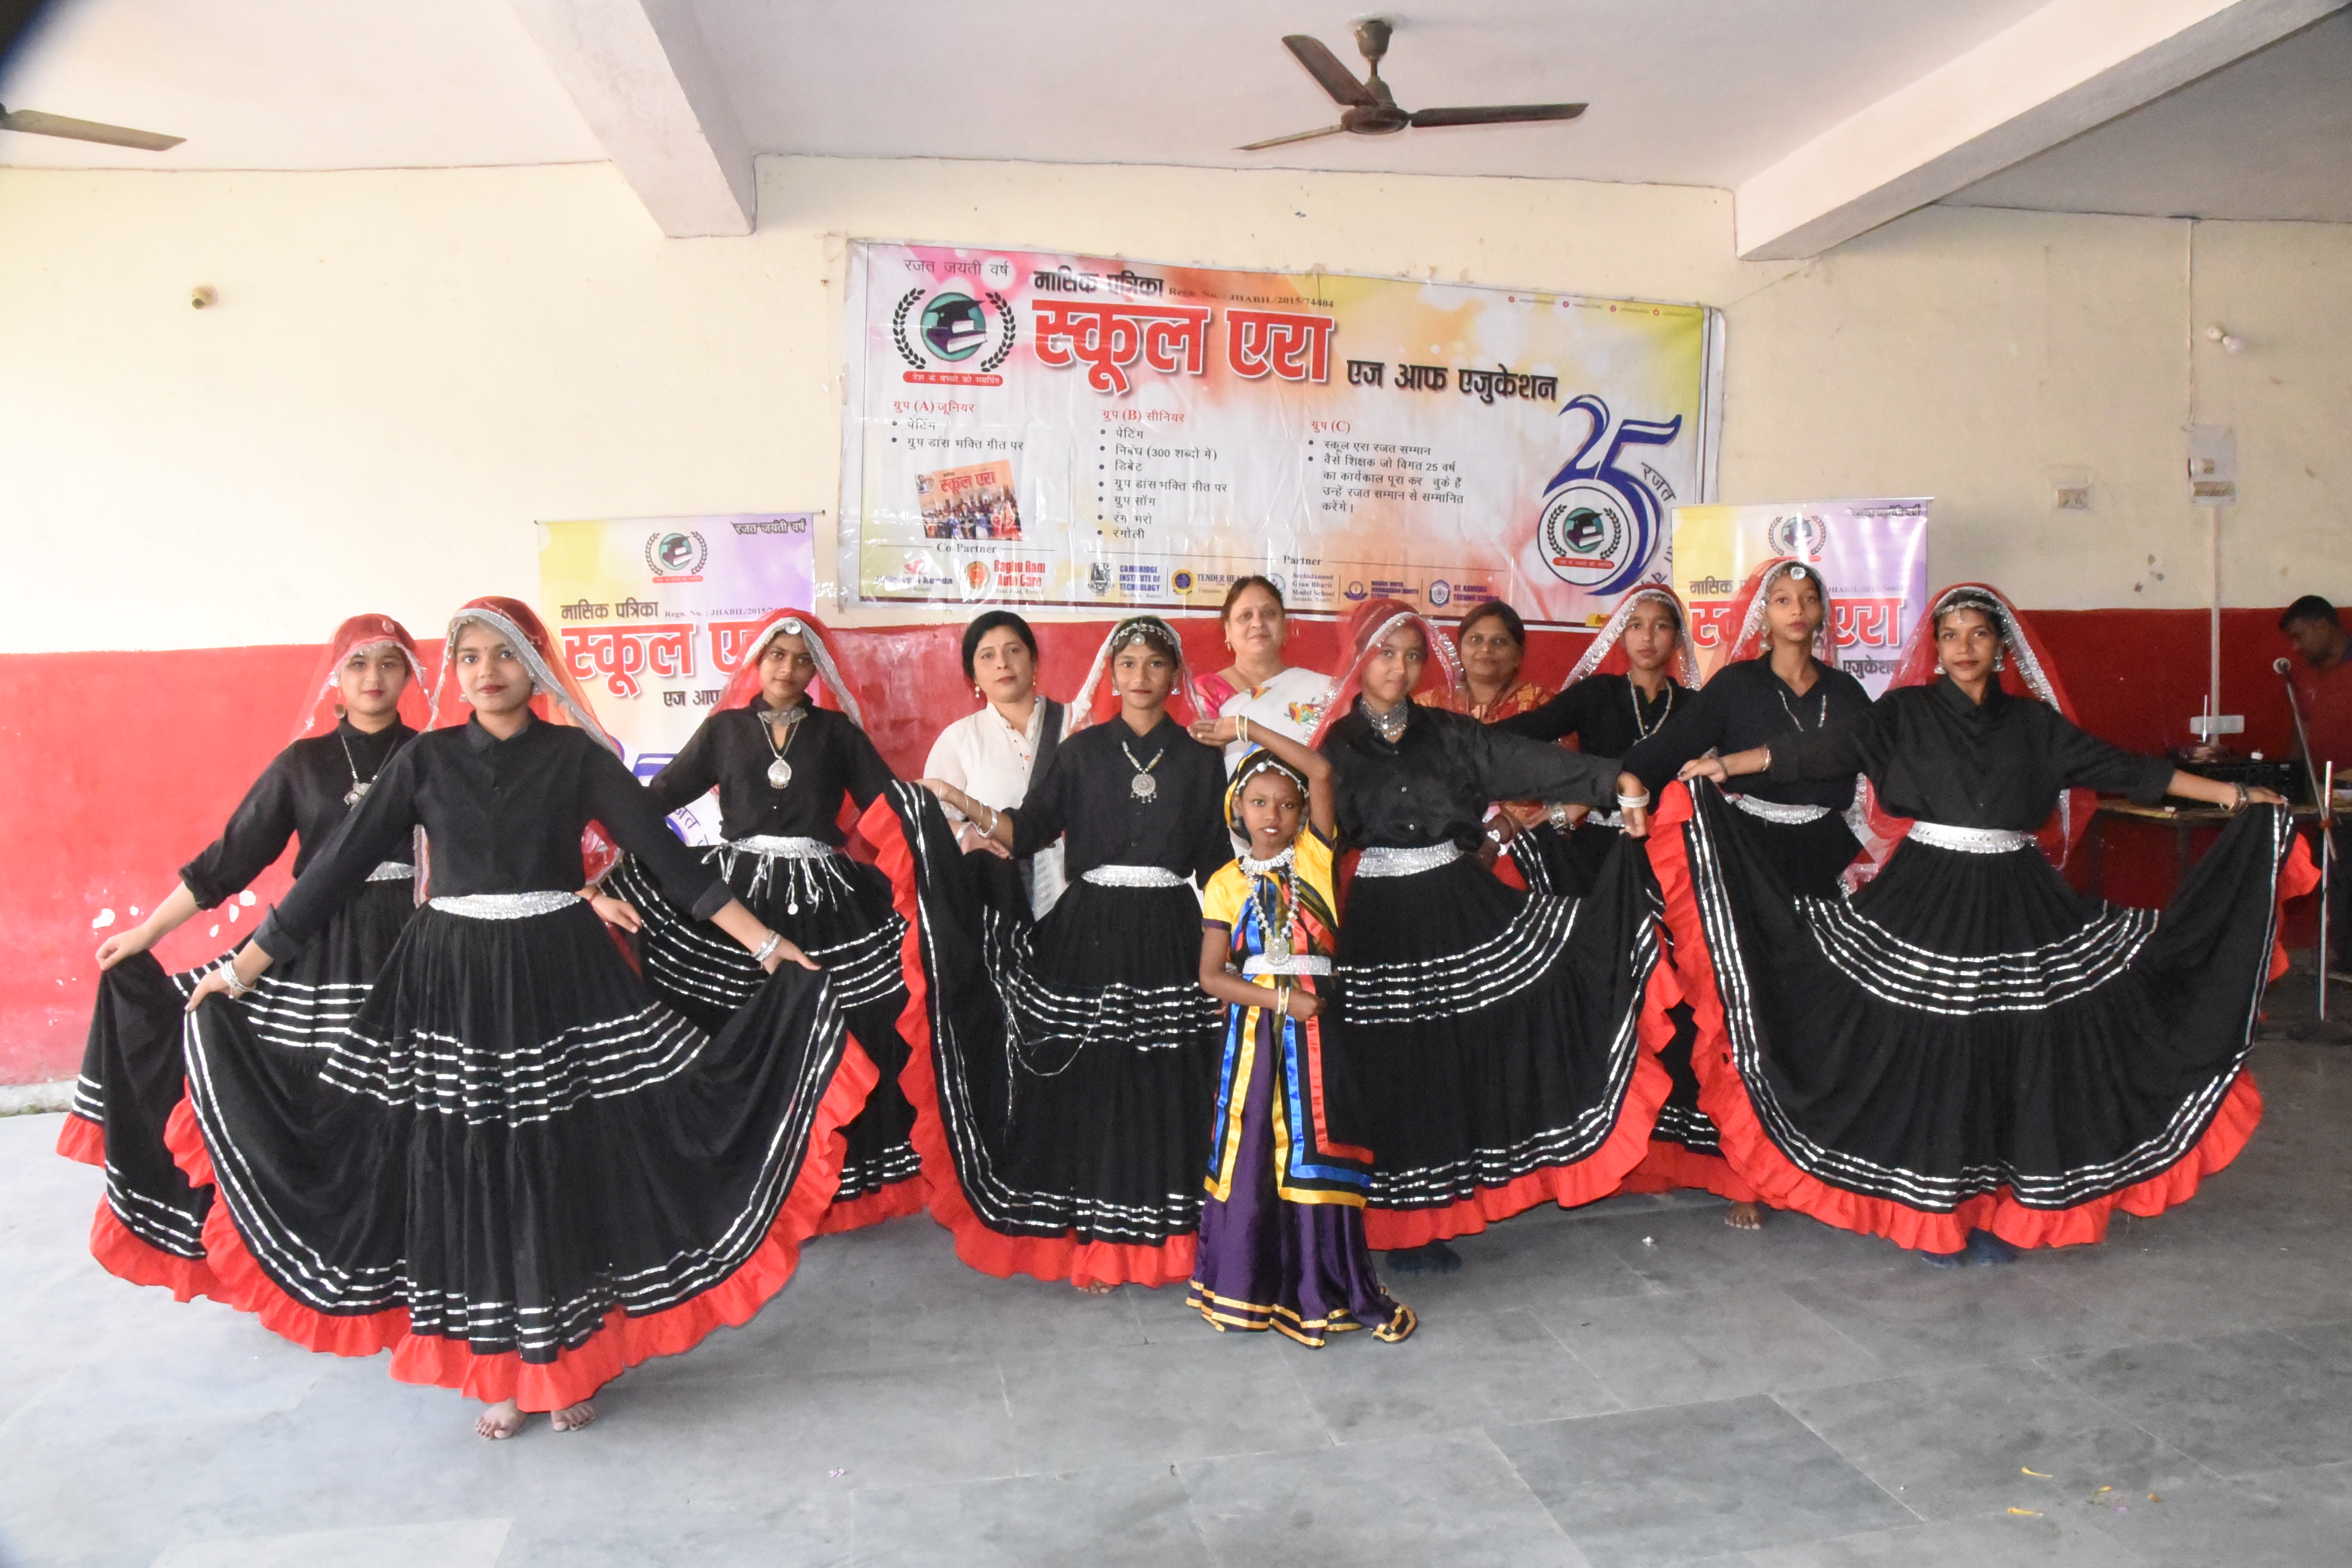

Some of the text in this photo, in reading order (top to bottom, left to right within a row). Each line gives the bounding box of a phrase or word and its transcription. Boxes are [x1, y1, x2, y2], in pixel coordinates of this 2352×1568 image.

[904, 259, 1009, 276] रजत जयंती वर्ष
[1033, 265, 1164, 297] मासिक पत्रिका
[1031, 299, 1335, 396] स्कूल एरा
[1346, 359, 1558, 405] एज आफ एजुकेशन
[914, 400, 935, 414] (A)
[938, 400, 975, 415] जूनियर
[1122, 409, 1142, 422] (B)
[1146, 410, 1186, 422] सीनियर
[1331, 420, 1351, 434] (C)
[928, 436, 950, 448] डांस
[956, 437, 983, 449] भक्ति
[987, 438, 1006, 449] गीत
[1010, 441, 1024, 451] पर
[1116, 443, 1143, 456] निबंध
[1147, 445, 1171, 460] (300
[1324, 440, 1431, 457] स्कूल एरा रजत सम्मान
[1115, 458, 1142, 472] डिबेट
[1324, 452, 1456, 473] वैसे शिक्षक जो विगत 25 वर्ष
[939, 470, 997, 494] स्कूल एरा
[1135, 477, 1157, 489] डांस
[1159, 478, 1186, 492] भक्ति
[1192, 480, 1211, 492] गीत
[1214, 483, 1228, 493] पर
[1323, 470, 1336, 480] का
[1340, 469, 1383, 484] कार्यकाल
[1388, 474, 1405, 488] पूरा
[1408, 476, 1423, 487] कर
[1432, 475, 1450, 491] चुके
[1641, 462, 1677, 501] रजत
[1347, 488, 1370, 499] रजत
[1374, 489, 1405, 501] सम्मान
[1408, 489, 1418, 501] से
[1422, 491, 1464, 504] सम्मानित
[731, 517, 807, 535] रजत जयंती वर्ष
[1113, 512, 1128, 523] रंग
[1113, 526, 1146, 539] रंगोली
[1025, 560, 1046, 574] Ram
[1283, 555, 1322, 566] Partner
[1020, 574, 1042, 587] Care
[1197, 573, 1225, 582] TENDER
[560, 597, 659, 620] मासिक पत्रिका
[1829, 598, 1904, 648] एरा
[561, 623, 696, 698] स्कूल
[662, 690, 687, 707] एज
